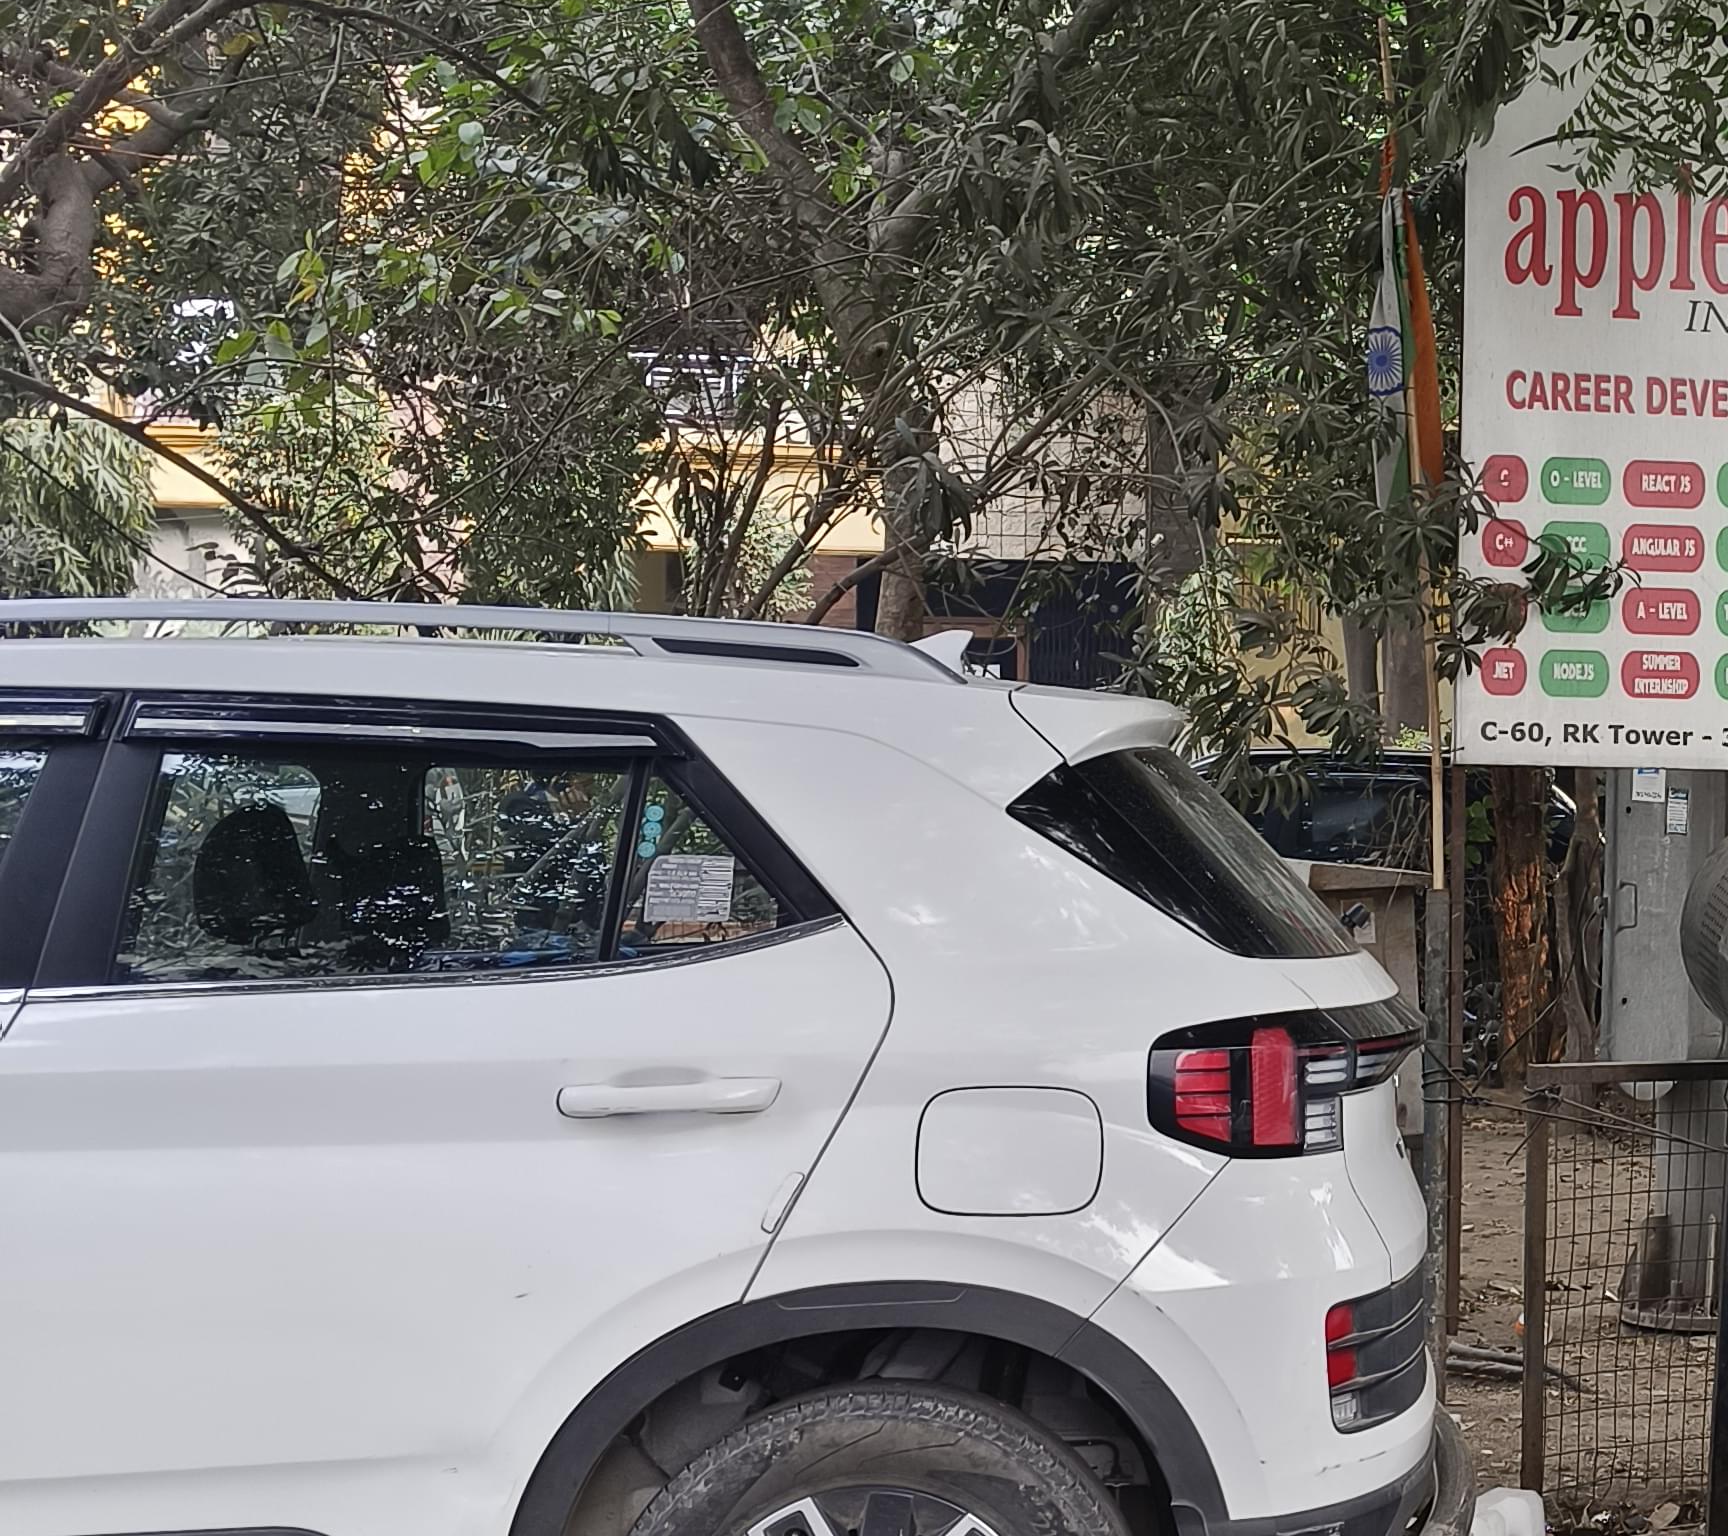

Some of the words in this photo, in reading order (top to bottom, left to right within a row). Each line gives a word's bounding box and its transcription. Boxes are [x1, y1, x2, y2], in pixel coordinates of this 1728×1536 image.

[1505, 370, 1635, 414] CAREER
[1573, 473, 1602, 489] LEVEL
[1642, 474, 1676, 493] REACT
[1679, 476, 1691, 493] JS
[1632, 537, 1680, 556] ANGULAR
[1684, 540, 1696, 557] JS
[1637, 604, 1646, 619] A
[1659, 603, 1688, 621] LEVEL
[1642, 654, 1681, 672] SUMMER
[1634, 678, 1689, 695] INTERNSHIP
[1480, 721, 1552, 747] C-60,
[1563, 723, 1600, 744] RK
[1608, 724, 1694, 747] Tower
